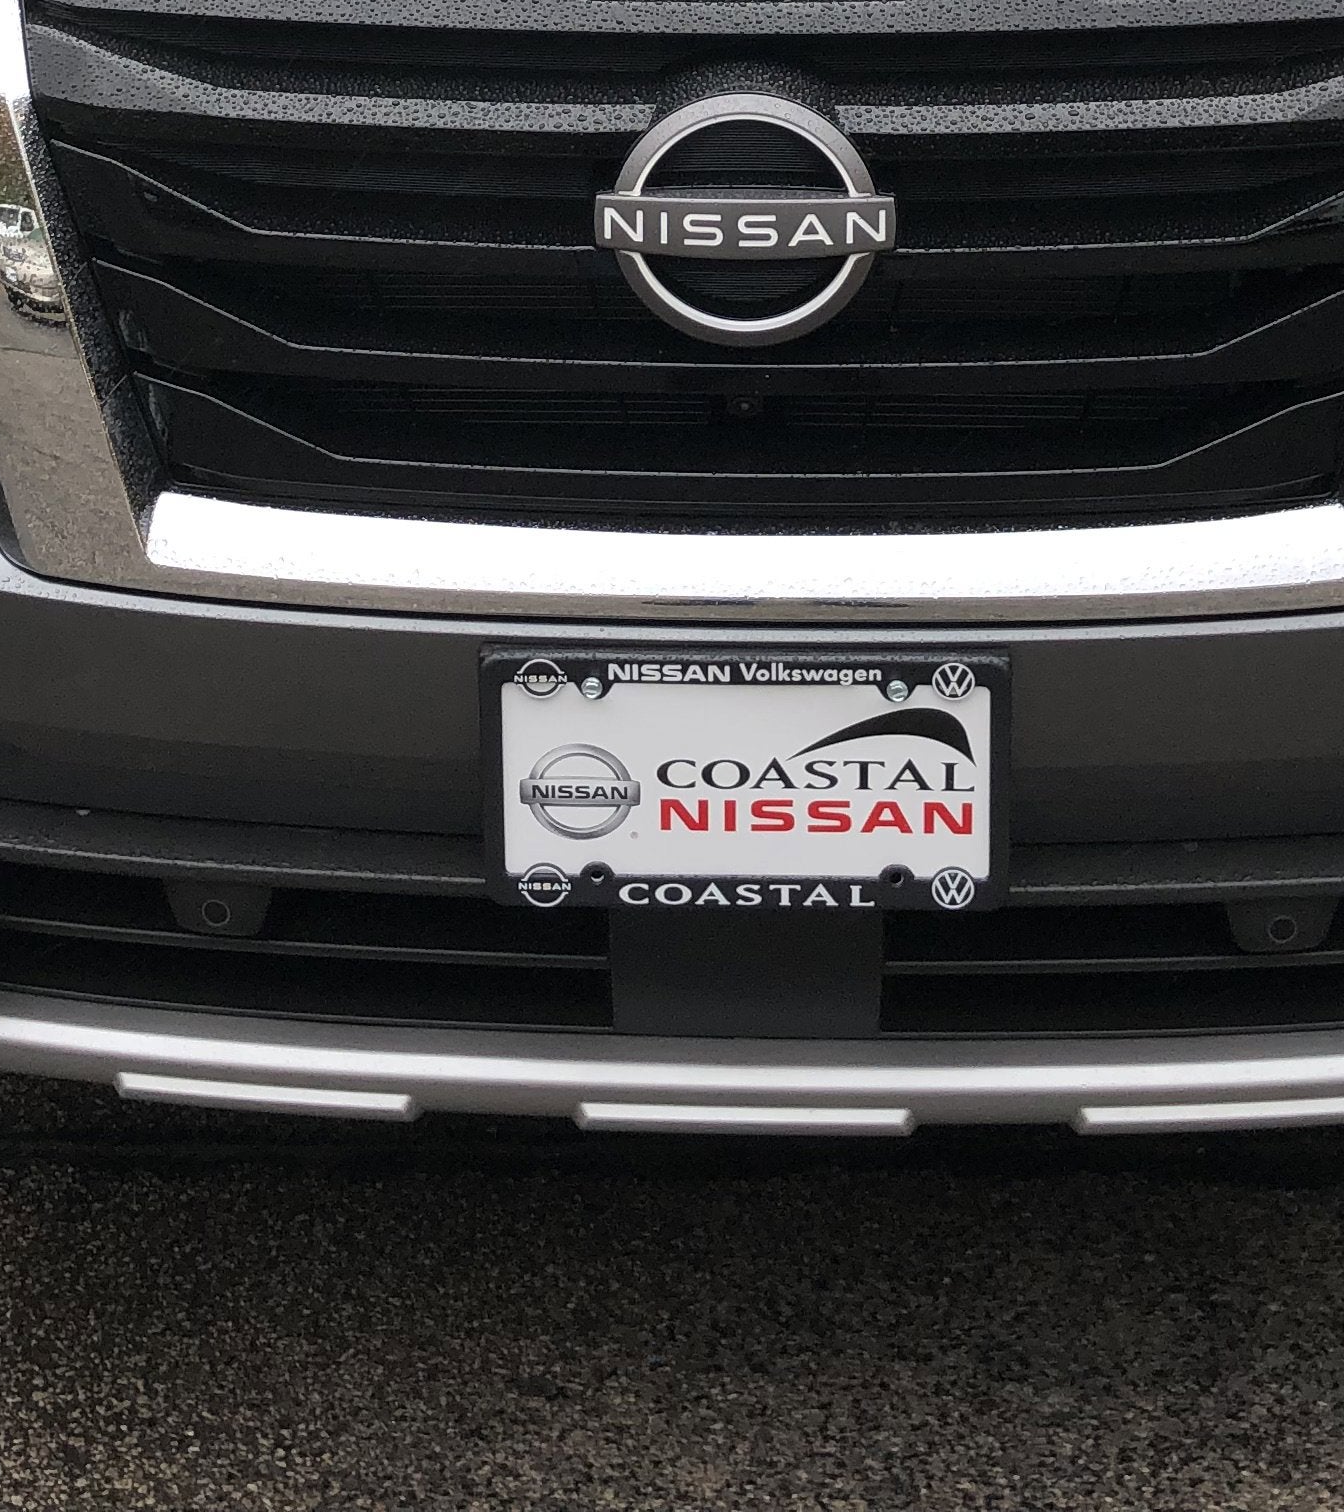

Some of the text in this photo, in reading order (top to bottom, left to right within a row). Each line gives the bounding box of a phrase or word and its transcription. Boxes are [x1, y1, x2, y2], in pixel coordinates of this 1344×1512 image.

[603, 207, 887, 248] NISSAN
[513, 674, 568, 683] NISSAN
[607, 662, 883, 686] NISSAN Volkswagen
[656, 757, 976, 792] COASTAL
[531, 784, 629, 800] NISSAN
[659, 798, 974, 835] NISSAN
[517, 882, 572, 891] NISSAN
[618, 882, 876, 908] COASTAL
